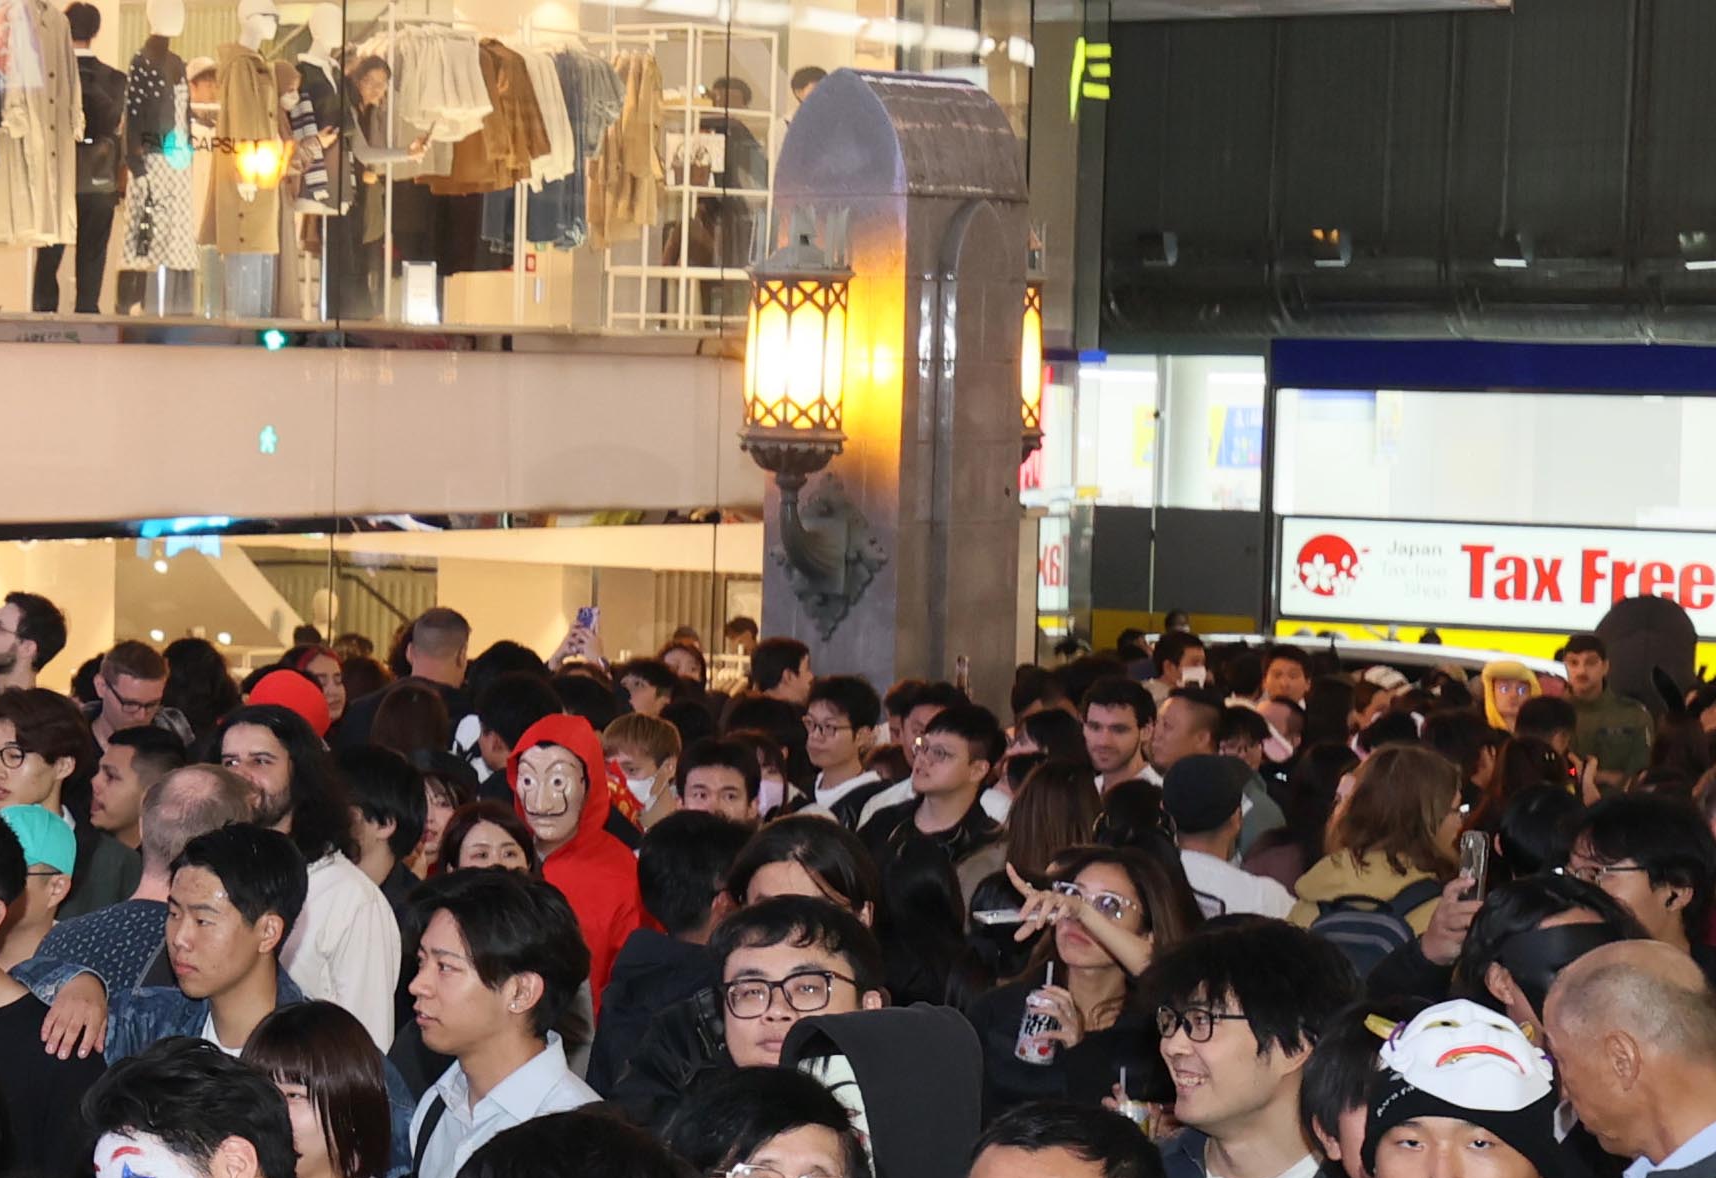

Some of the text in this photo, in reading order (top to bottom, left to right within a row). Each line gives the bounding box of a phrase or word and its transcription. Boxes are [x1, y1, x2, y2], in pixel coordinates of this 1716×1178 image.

[1387, 539, 1444, 560] Japan
[1460, 544, 1716, 610] Tax Free
